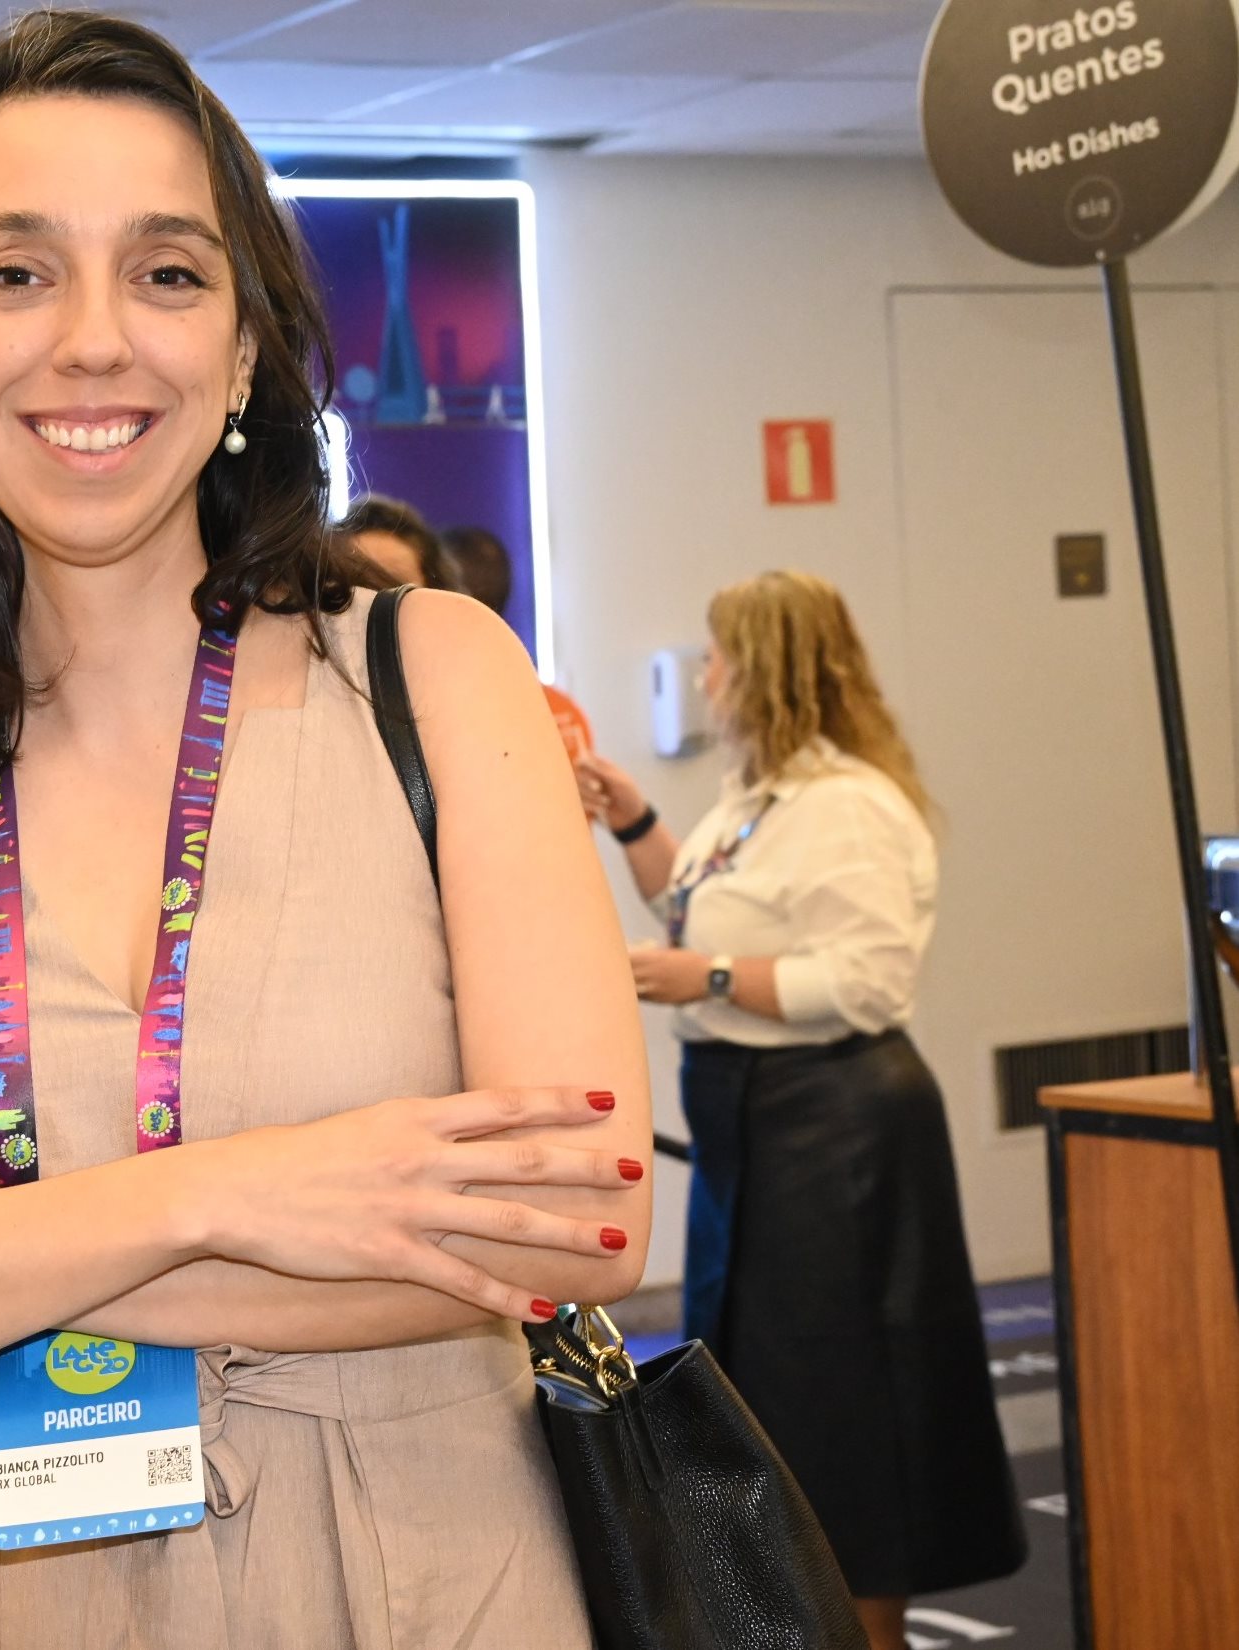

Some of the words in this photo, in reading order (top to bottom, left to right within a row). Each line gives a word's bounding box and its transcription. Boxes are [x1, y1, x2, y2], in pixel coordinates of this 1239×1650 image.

[1008, 0, 1137, 63] Pratos
[992, 38, 1165, 115] Quentes
[1012, 140, 1065, 176] Hot
[1067, 116, 1160, 160] Dishes
[44, 1399, 142, 1432] PARCEIRO
[14, 1472, 57, 1488] GLOBAL
[44, 1451, 105, 1470] PIZZOLITO
